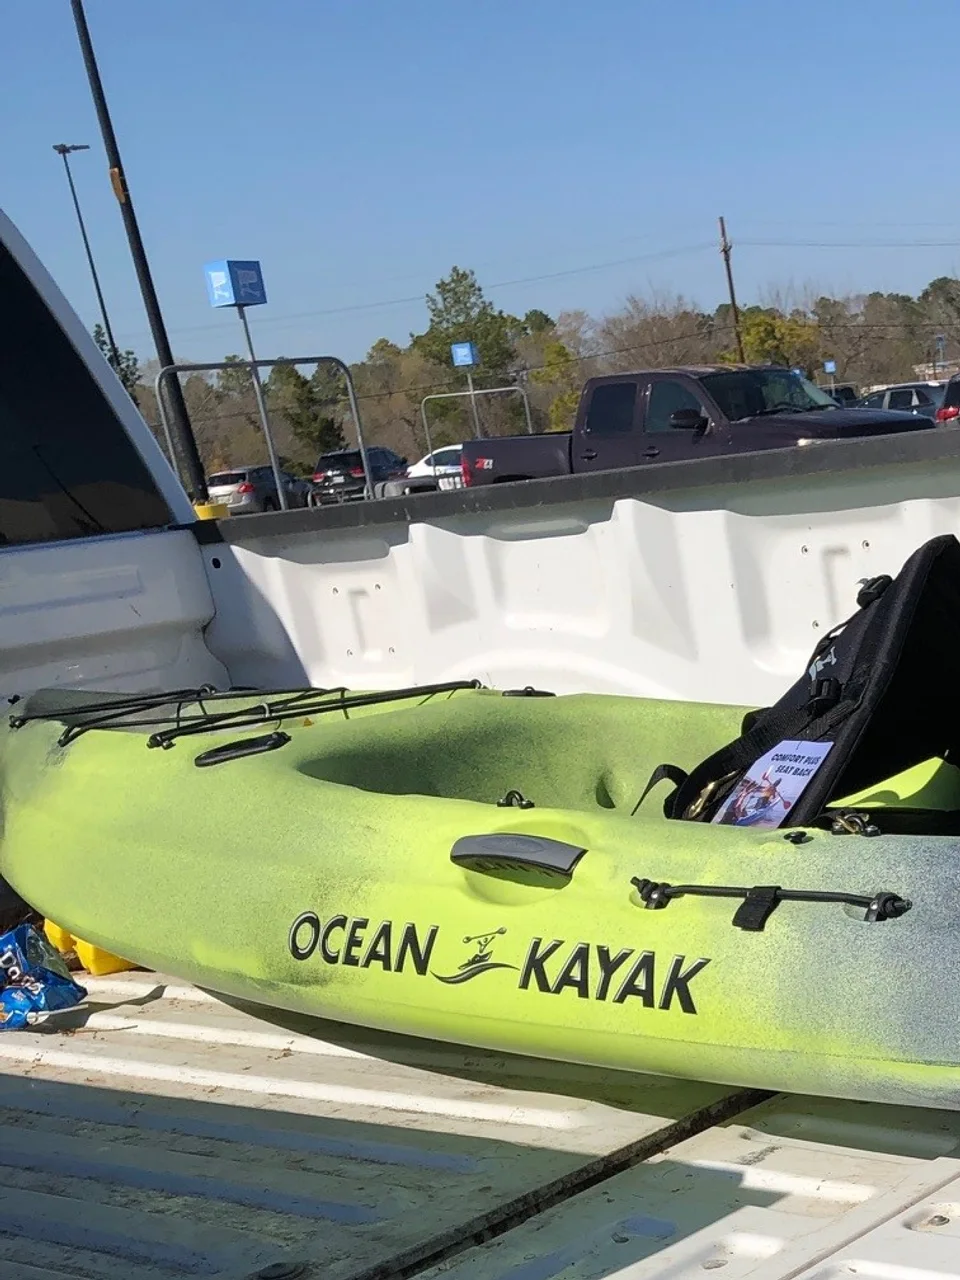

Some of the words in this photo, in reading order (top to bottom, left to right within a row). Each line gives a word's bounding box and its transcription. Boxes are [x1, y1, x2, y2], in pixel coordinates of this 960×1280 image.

[771, 753, 805, 763] COMFORT
[803, 755, 822, 765] PLUS
[775, 764, 794, 775] SEAT
[792, 767, 814, 777] BACK
[288, 911, 440, 976] OCEAN
[518, 937, 712, 1015] KAYAK
